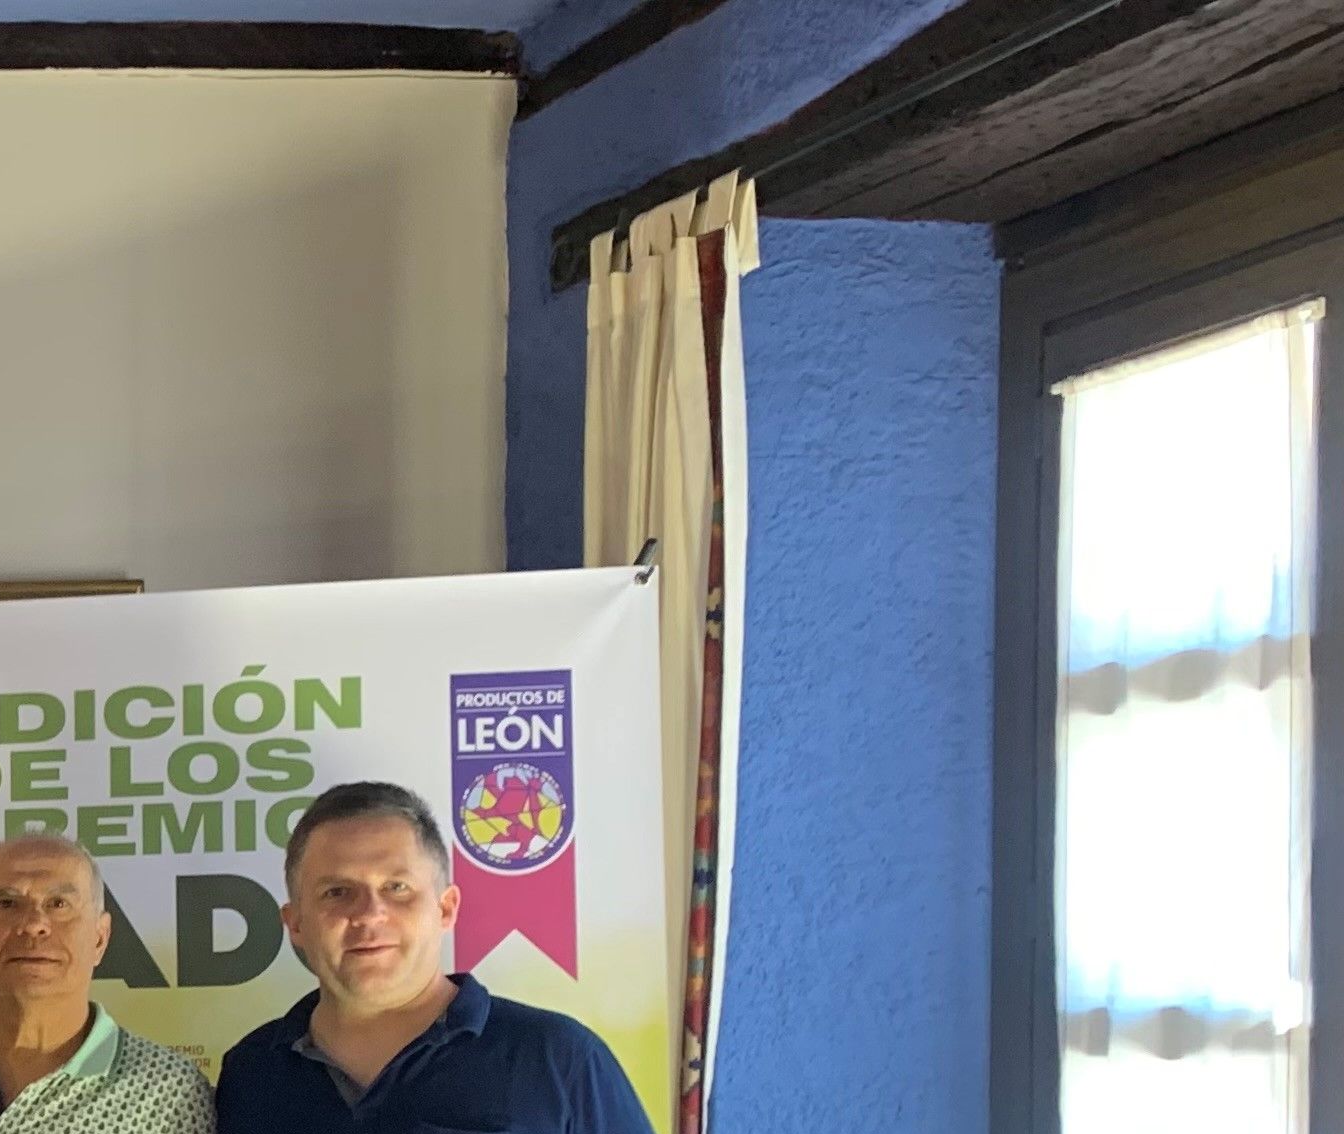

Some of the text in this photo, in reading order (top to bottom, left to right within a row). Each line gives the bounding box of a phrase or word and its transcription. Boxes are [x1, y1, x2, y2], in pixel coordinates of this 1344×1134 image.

[455, 689, 566, 708] PRODUCTOS DE
[457, 705, 564, 753] LEÓN
[110, 738, 315, 797] LOS
